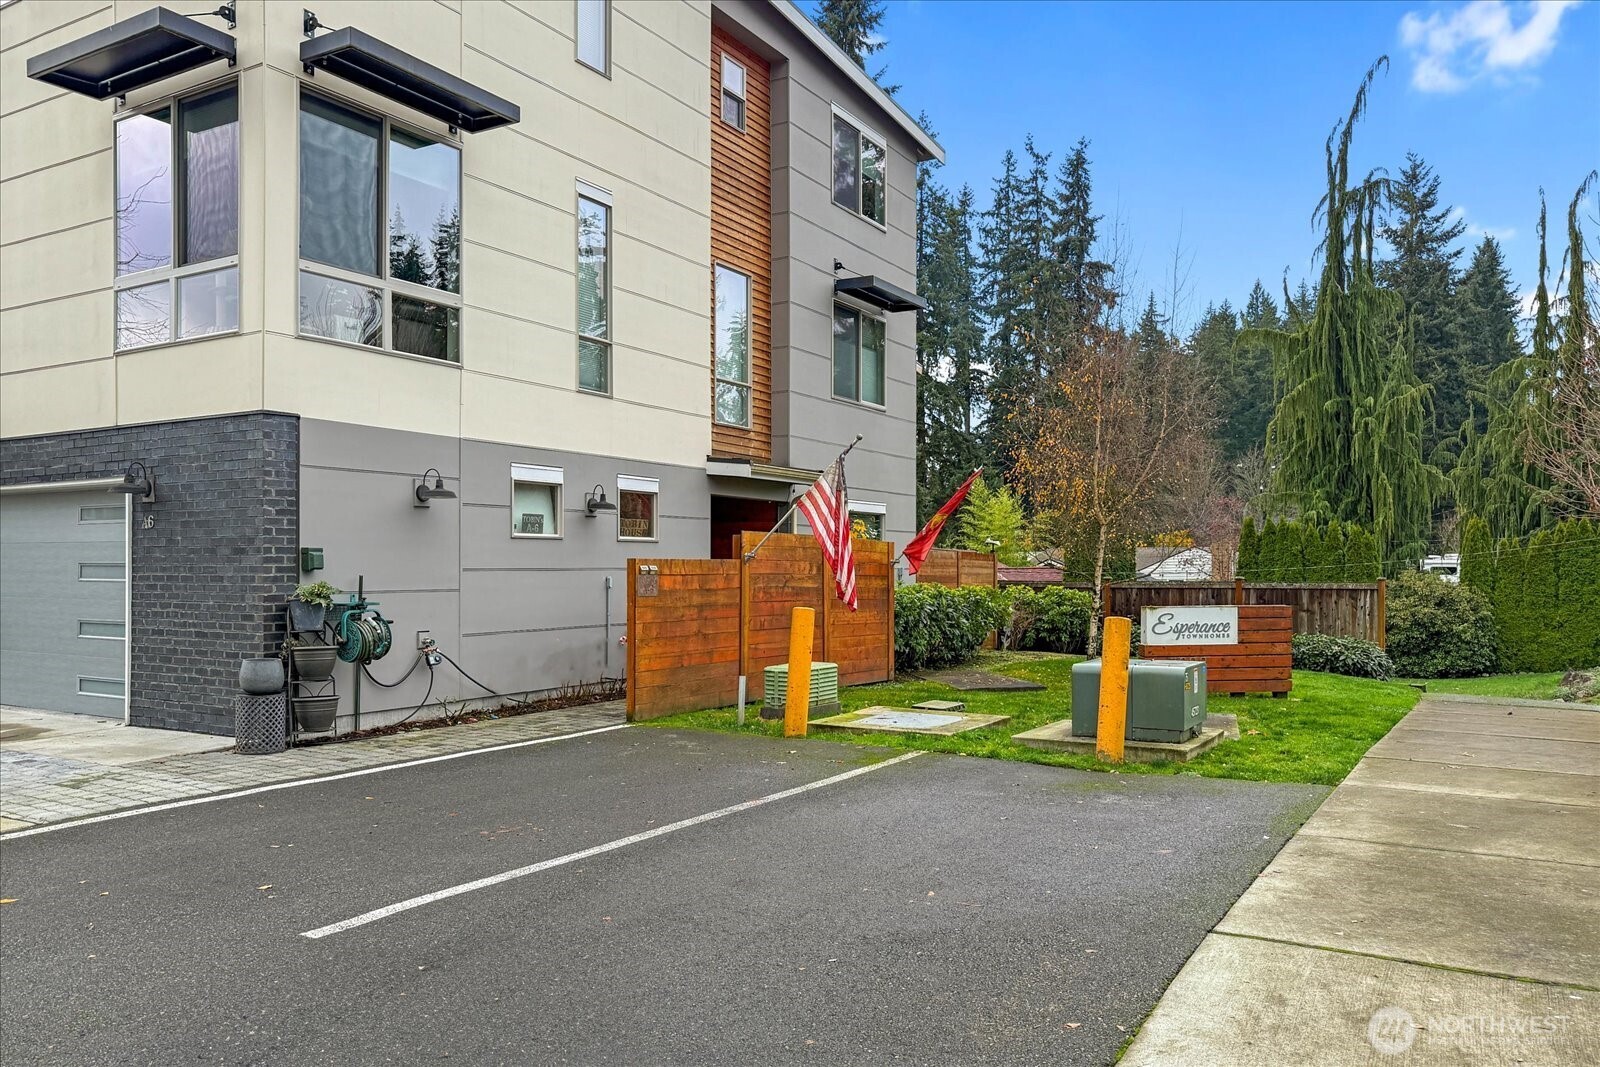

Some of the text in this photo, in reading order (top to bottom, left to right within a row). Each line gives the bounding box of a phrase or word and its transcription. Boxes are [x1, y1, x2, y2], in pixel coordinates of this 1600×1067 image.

[142, 515, 154, 529] A6
[526, 523, 539, 533] A-6
[1151, 612, 1231, 641] Esperance
